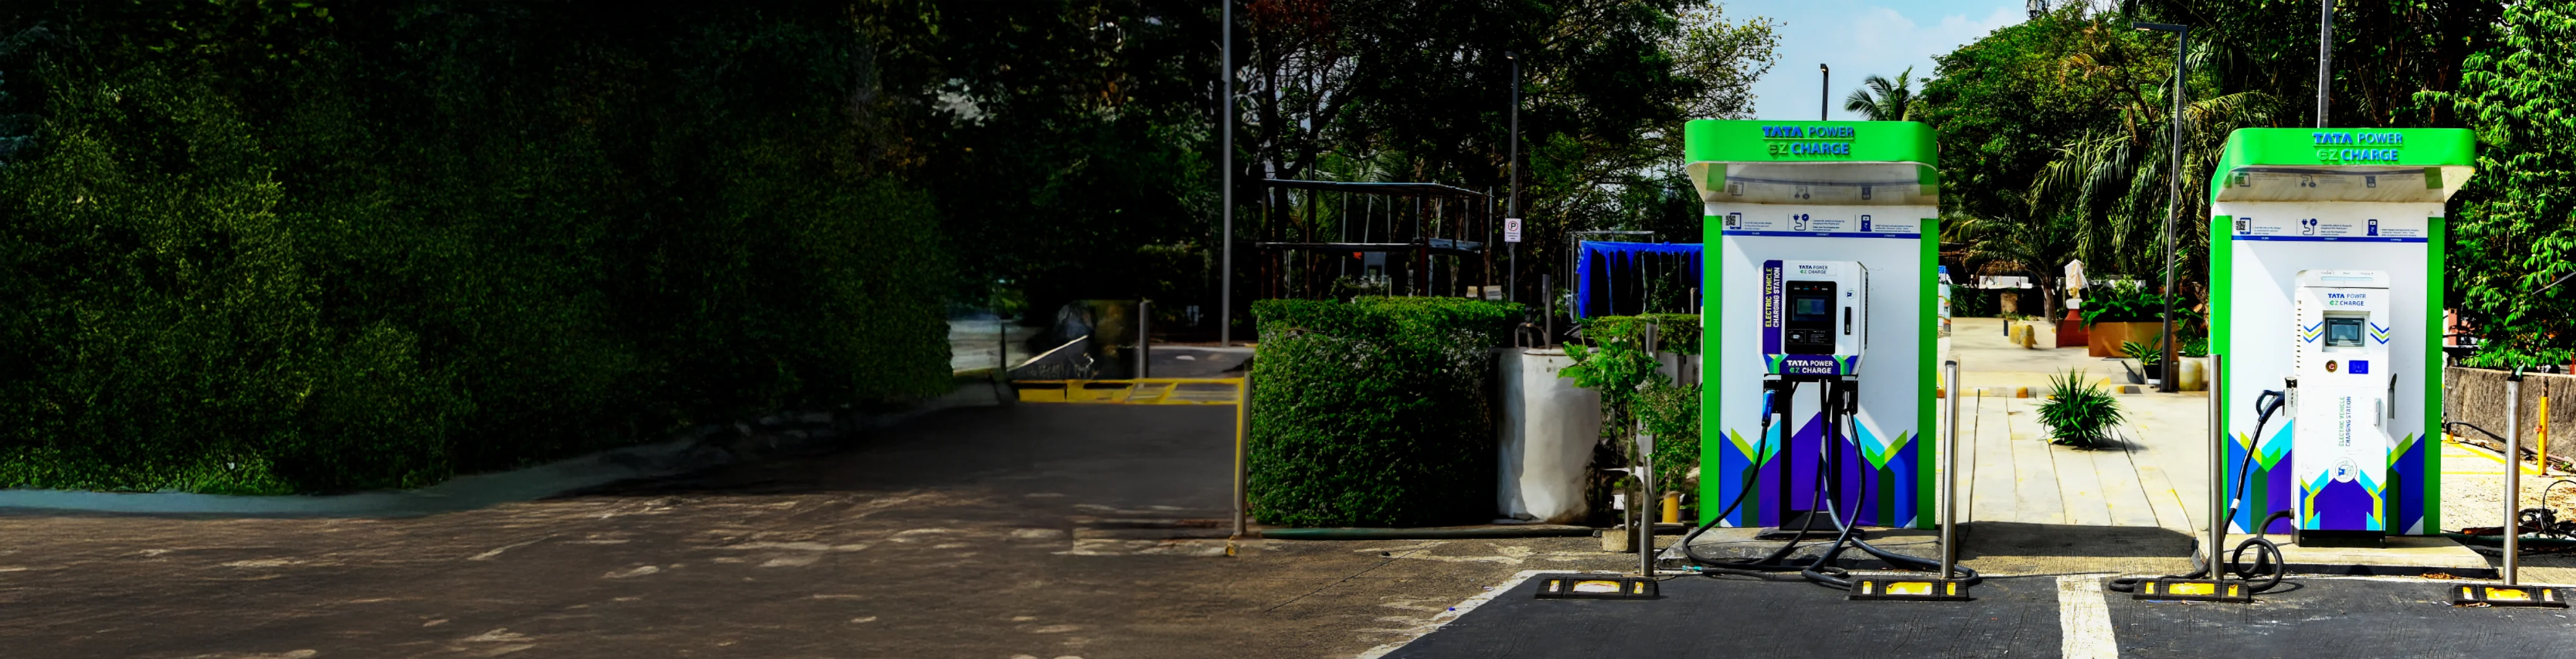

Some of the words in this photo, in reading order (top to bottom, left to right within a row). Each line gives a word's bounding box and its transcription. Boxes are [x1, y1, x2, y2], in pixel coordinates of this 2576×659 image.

[1762, 125, 1802, 137] TATA
[1808, 126, 1854, 137] POWER
[2312, 132, 2353, 144] TATA
[2357, 133, 2402, 144] POWER
[1790, 142, 1850, 154] CHARGE
[2341, 148, 2399, 161] CHARGE
